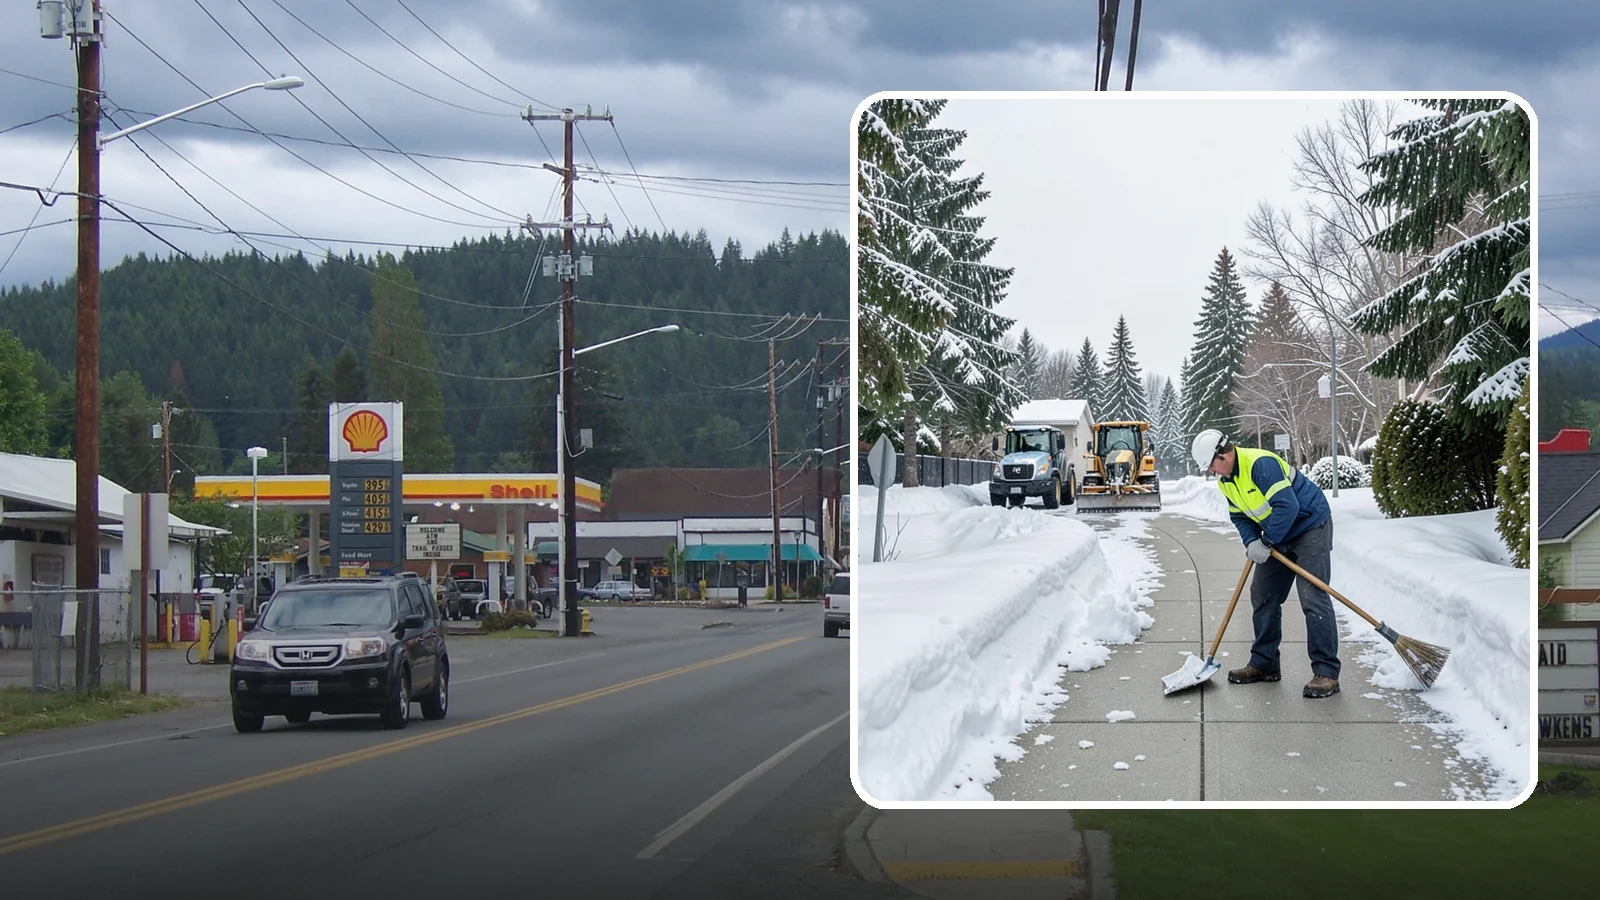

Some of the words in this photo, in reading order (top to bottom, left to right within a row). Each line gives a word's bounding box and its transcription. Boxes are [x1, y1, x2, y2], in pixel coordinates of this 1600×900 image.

[366, 480, 383, 490] 395
[490, 484, 547, 499] Shell
[366, 494, 383, 504] 405
[366, 508, 383, 518] 415
[366, 522, 383, 533] 429
